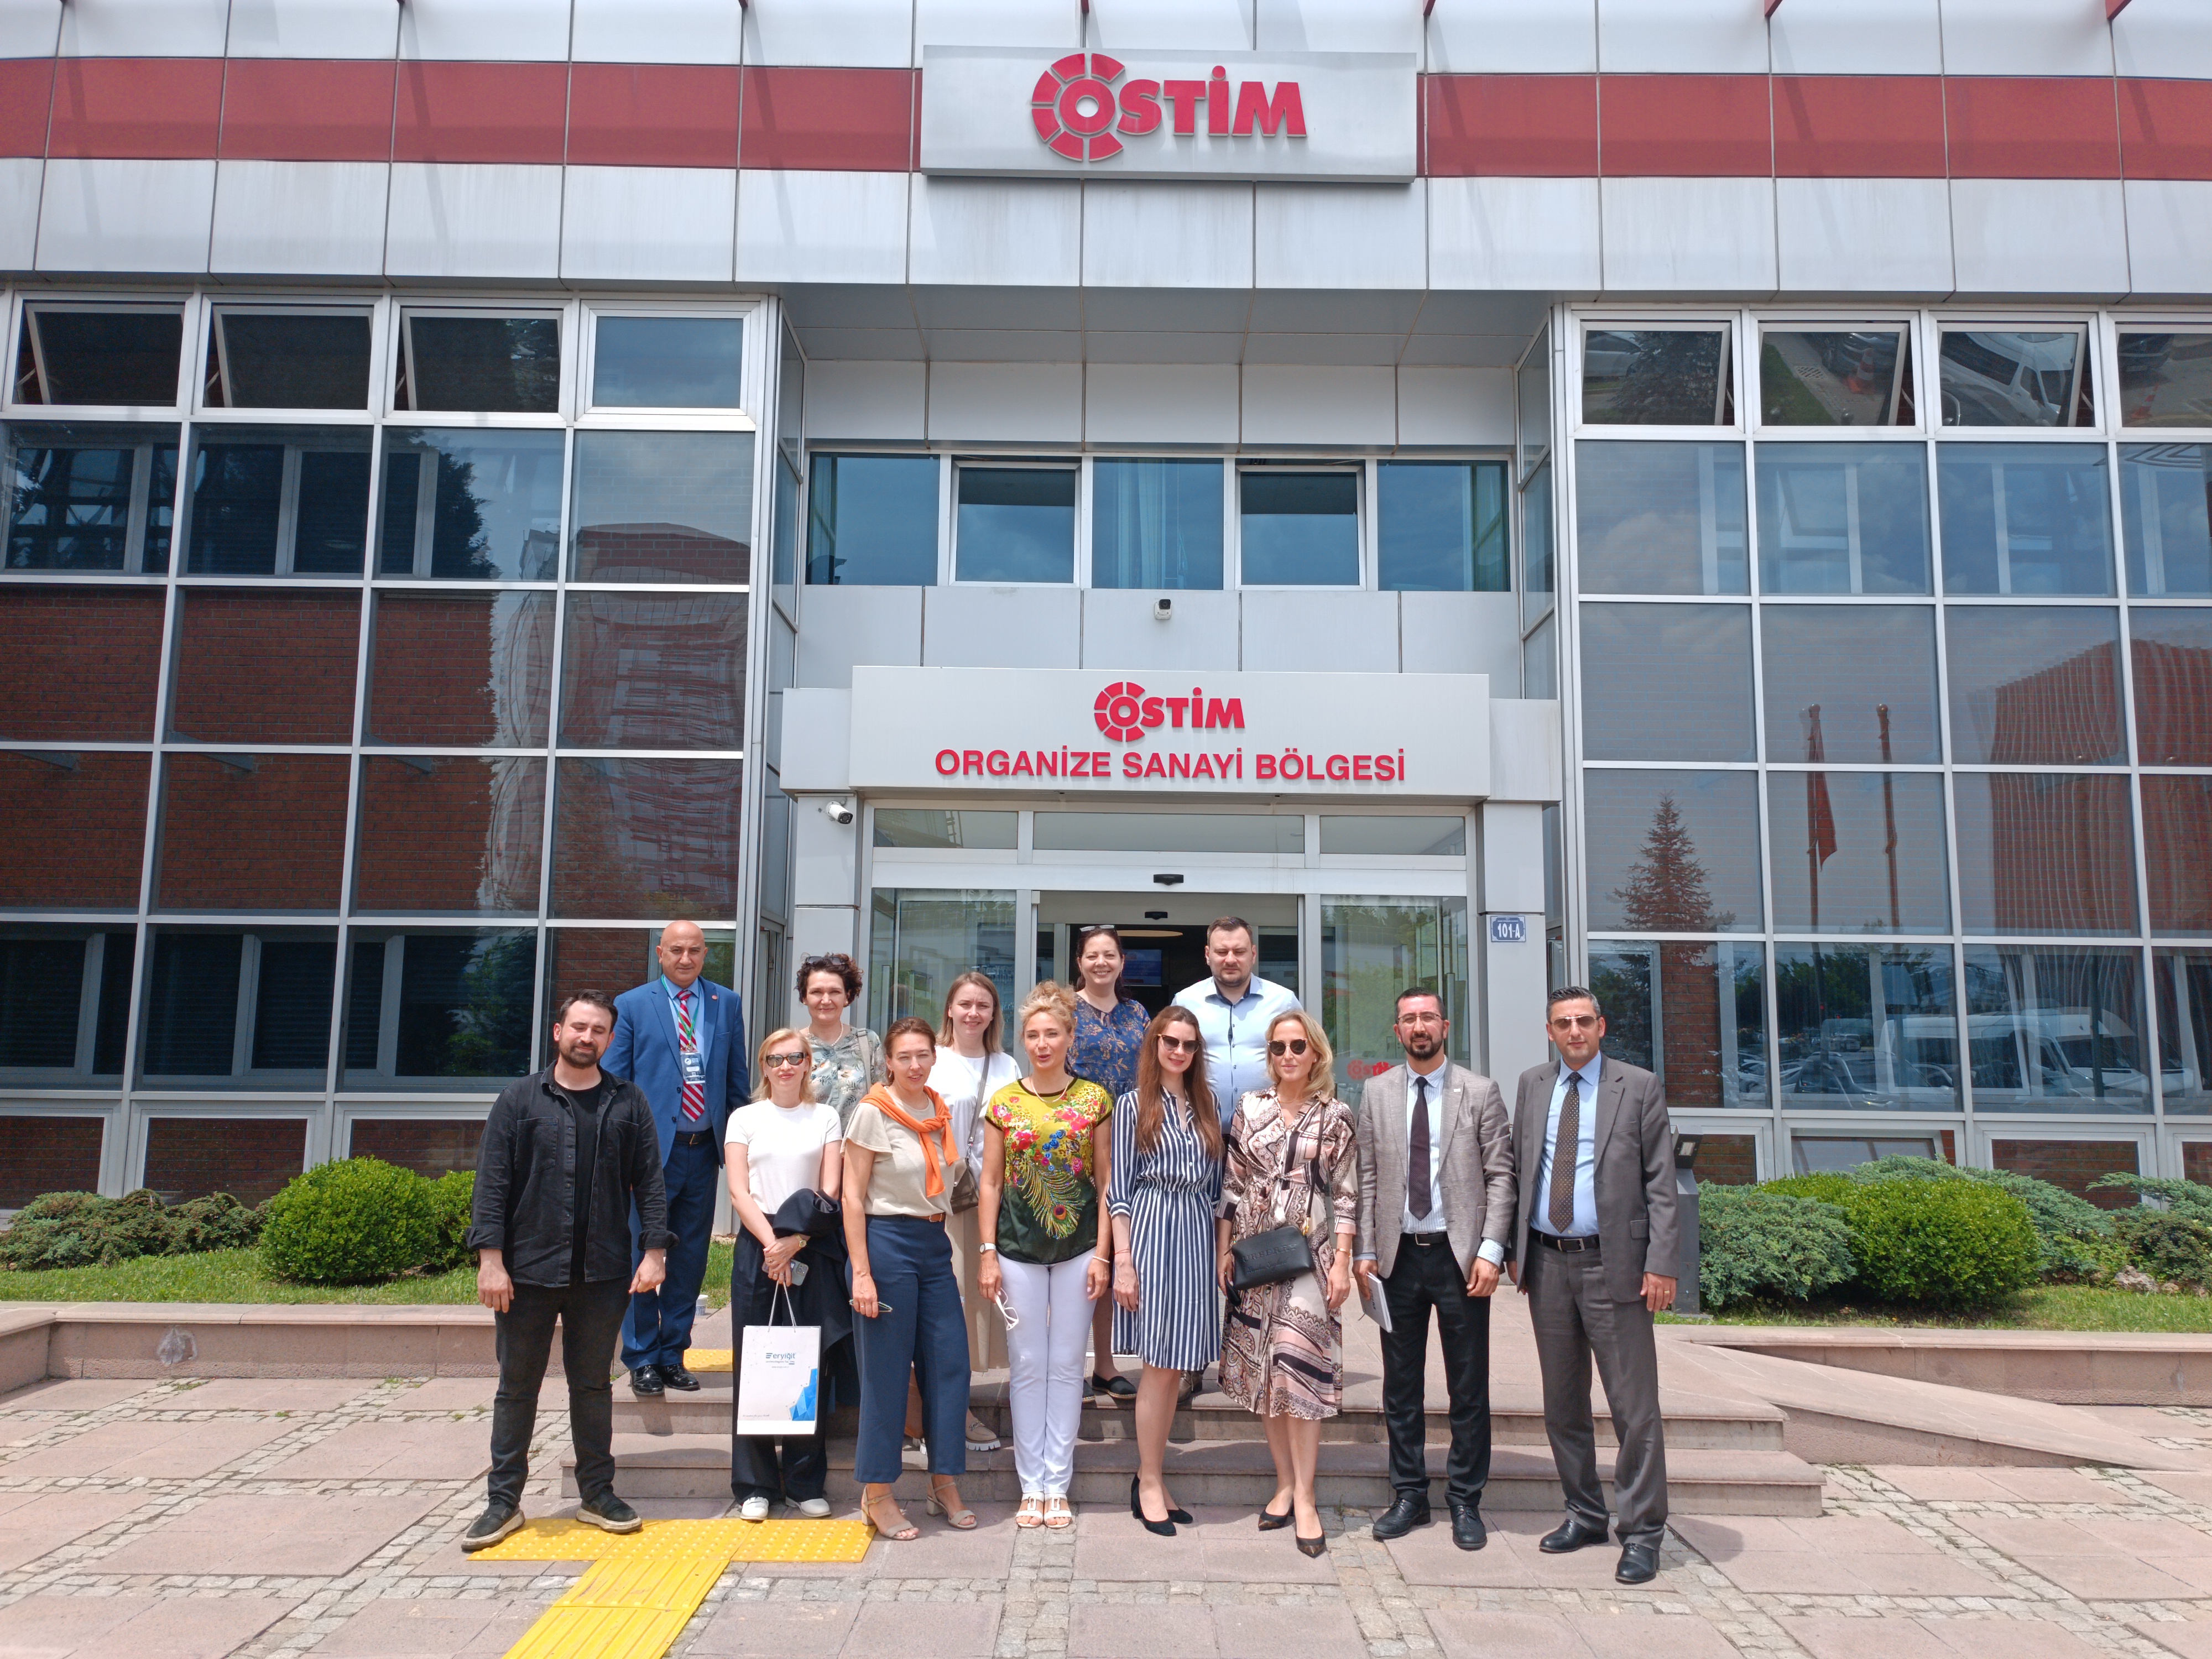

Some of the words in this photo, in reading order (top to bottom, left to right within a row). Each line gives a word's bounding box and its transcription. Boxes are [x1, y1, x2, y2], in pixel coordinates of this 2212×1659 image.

[935, 745, 1111, 778] ORGANİZE
[1123, 747, 1243, 779] SANAYİ
[1256, 748, 1405, 781] BÖLGESİ
[1498, 922, 1521, 938] 101-A
[1238, 1243, 1297, 1263] URBERRY
